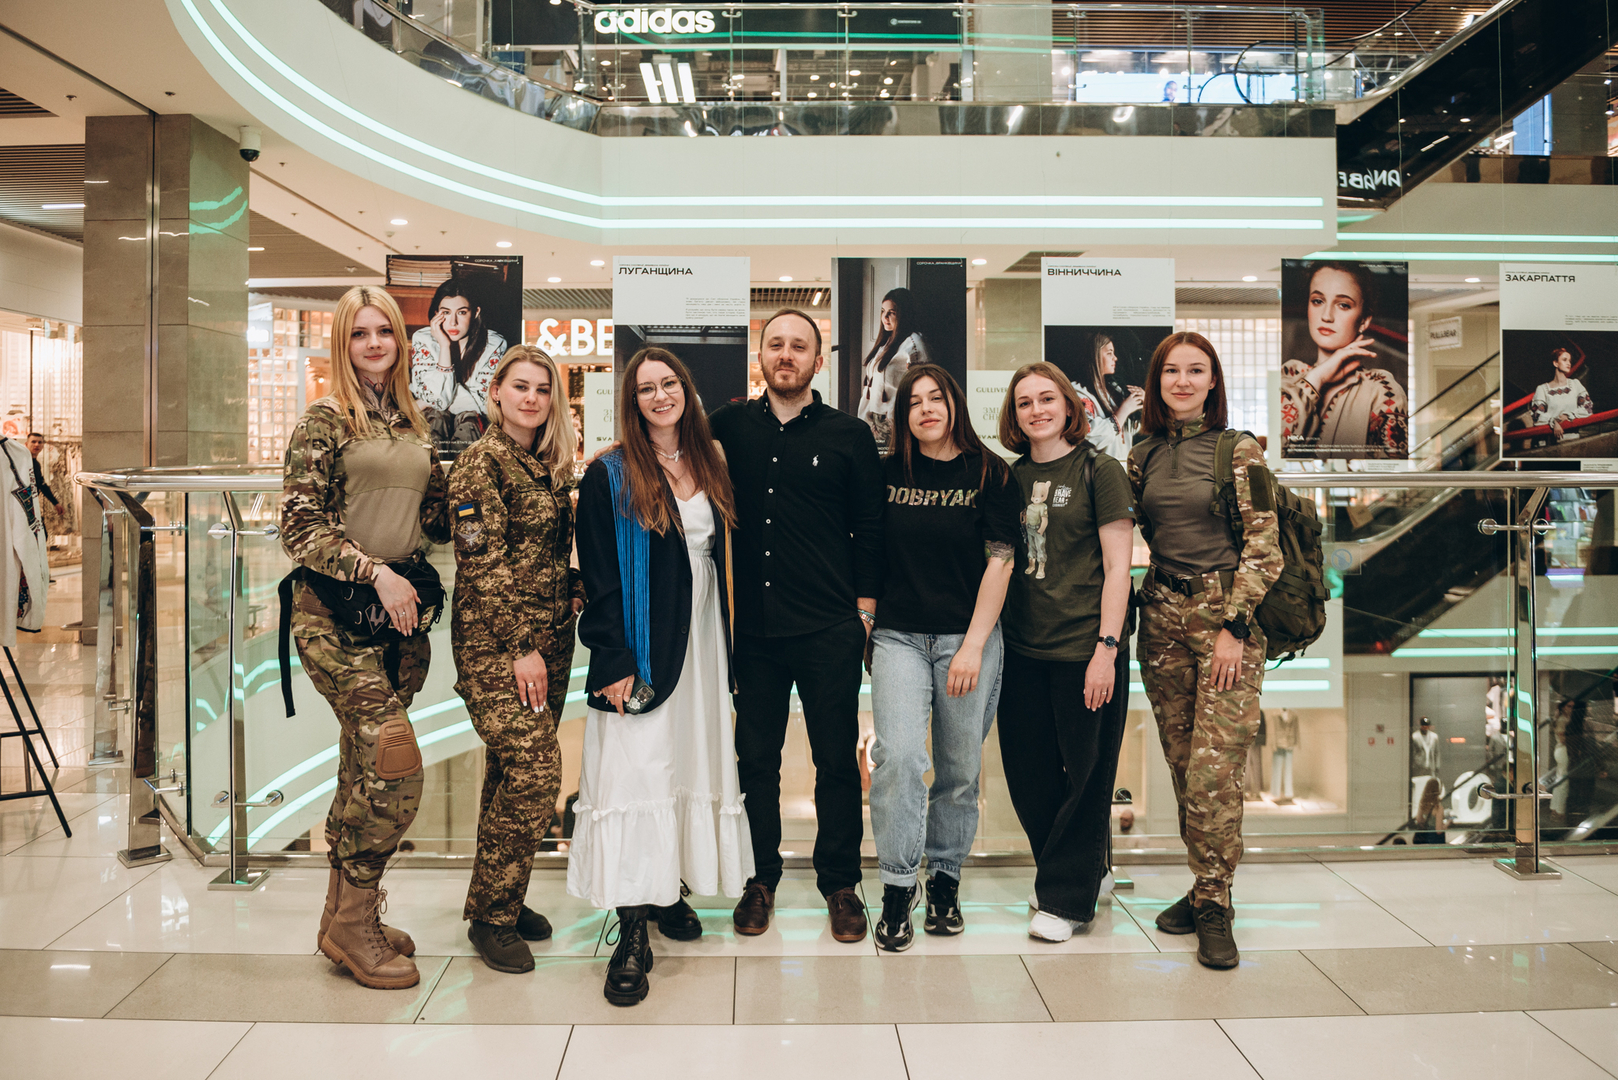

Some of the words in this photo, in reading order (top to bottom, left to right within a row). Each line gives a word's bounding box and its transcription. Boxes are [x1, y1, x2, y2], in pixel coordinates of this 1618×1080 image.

[594, 8, 716, 34] adidas
[618, 267, 694, 276] ЛУГАНЩИНА
[1047, 268, 1122, 276] ВІННИЧЧИНА
[1505, 274, 1576, 282] ЗАКАРПАТТЯ
[886, 484, 979, 508] DOBRYAK
